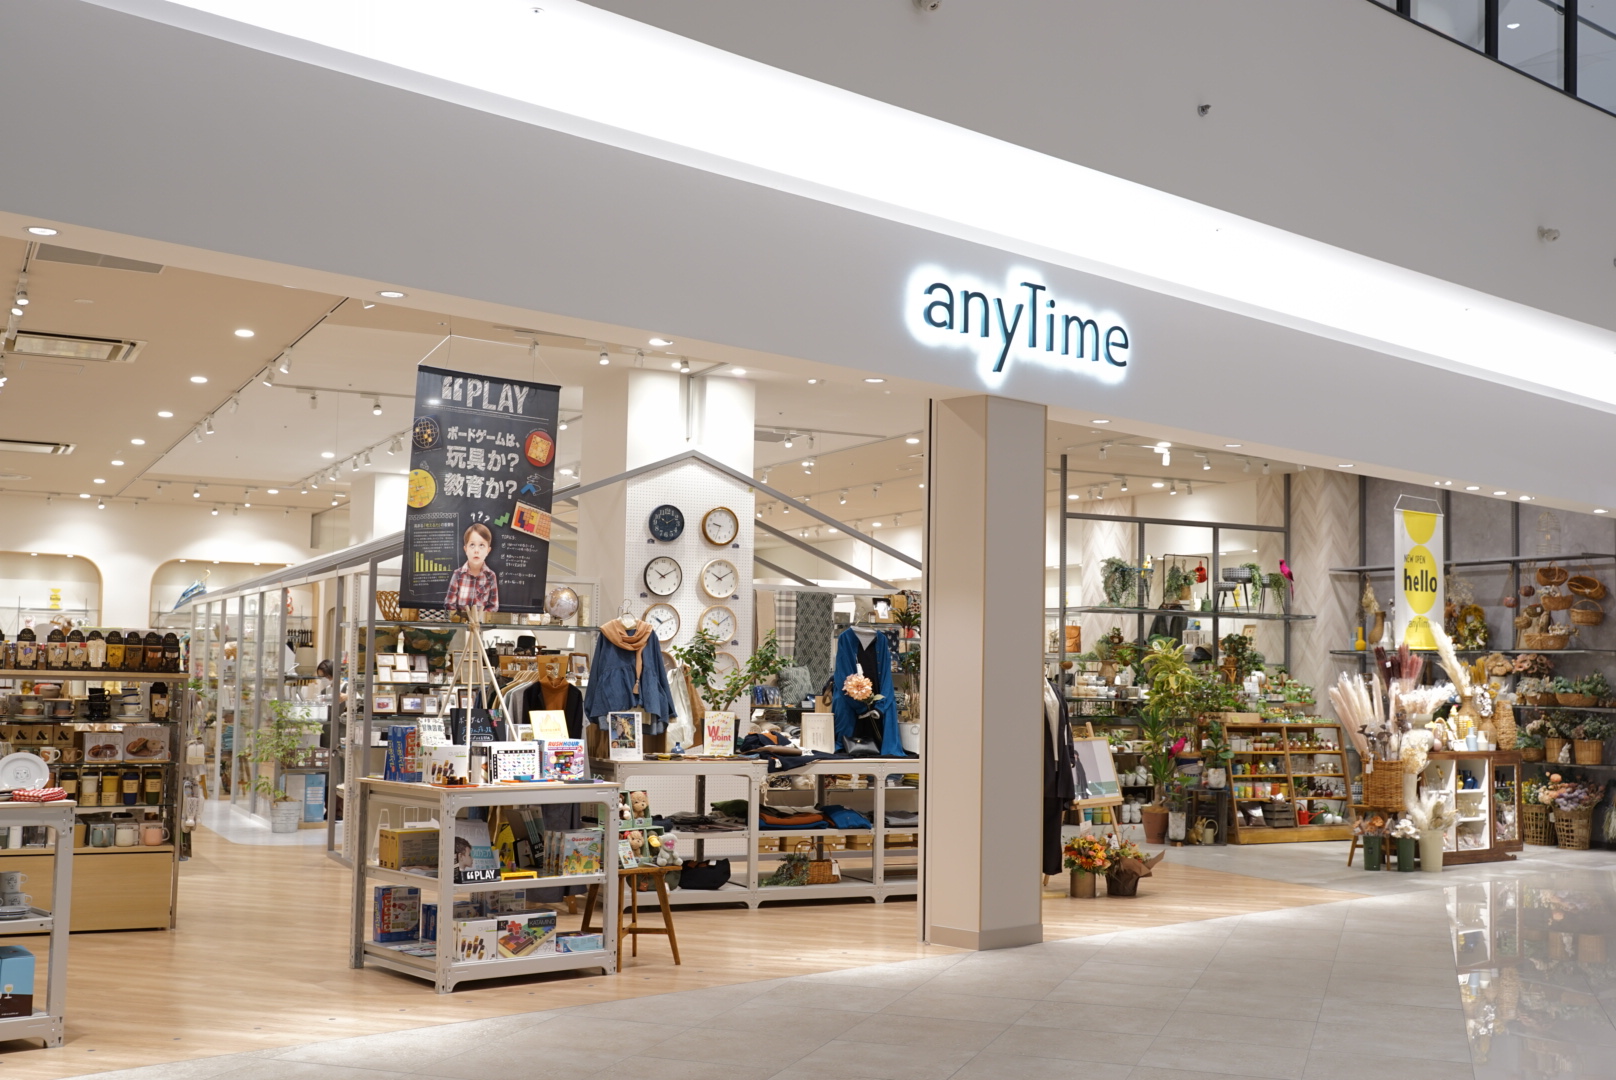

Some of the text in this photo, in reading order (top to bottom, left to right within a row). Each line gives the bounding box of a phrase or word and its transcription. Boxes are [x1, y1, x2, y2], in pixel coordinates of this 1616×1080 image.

[923, 282, 1129, 372] anyTime
[447, 426, 520, 448] ボードゲームは、
[1404, 554, 1426, 564] NEW OPEN
[1404, 568, 1438, 592] hello
[1409, 618, 1430, 632] anyTim
[708, 726, 720, 737] W
[712, 734, 732, 743] point
